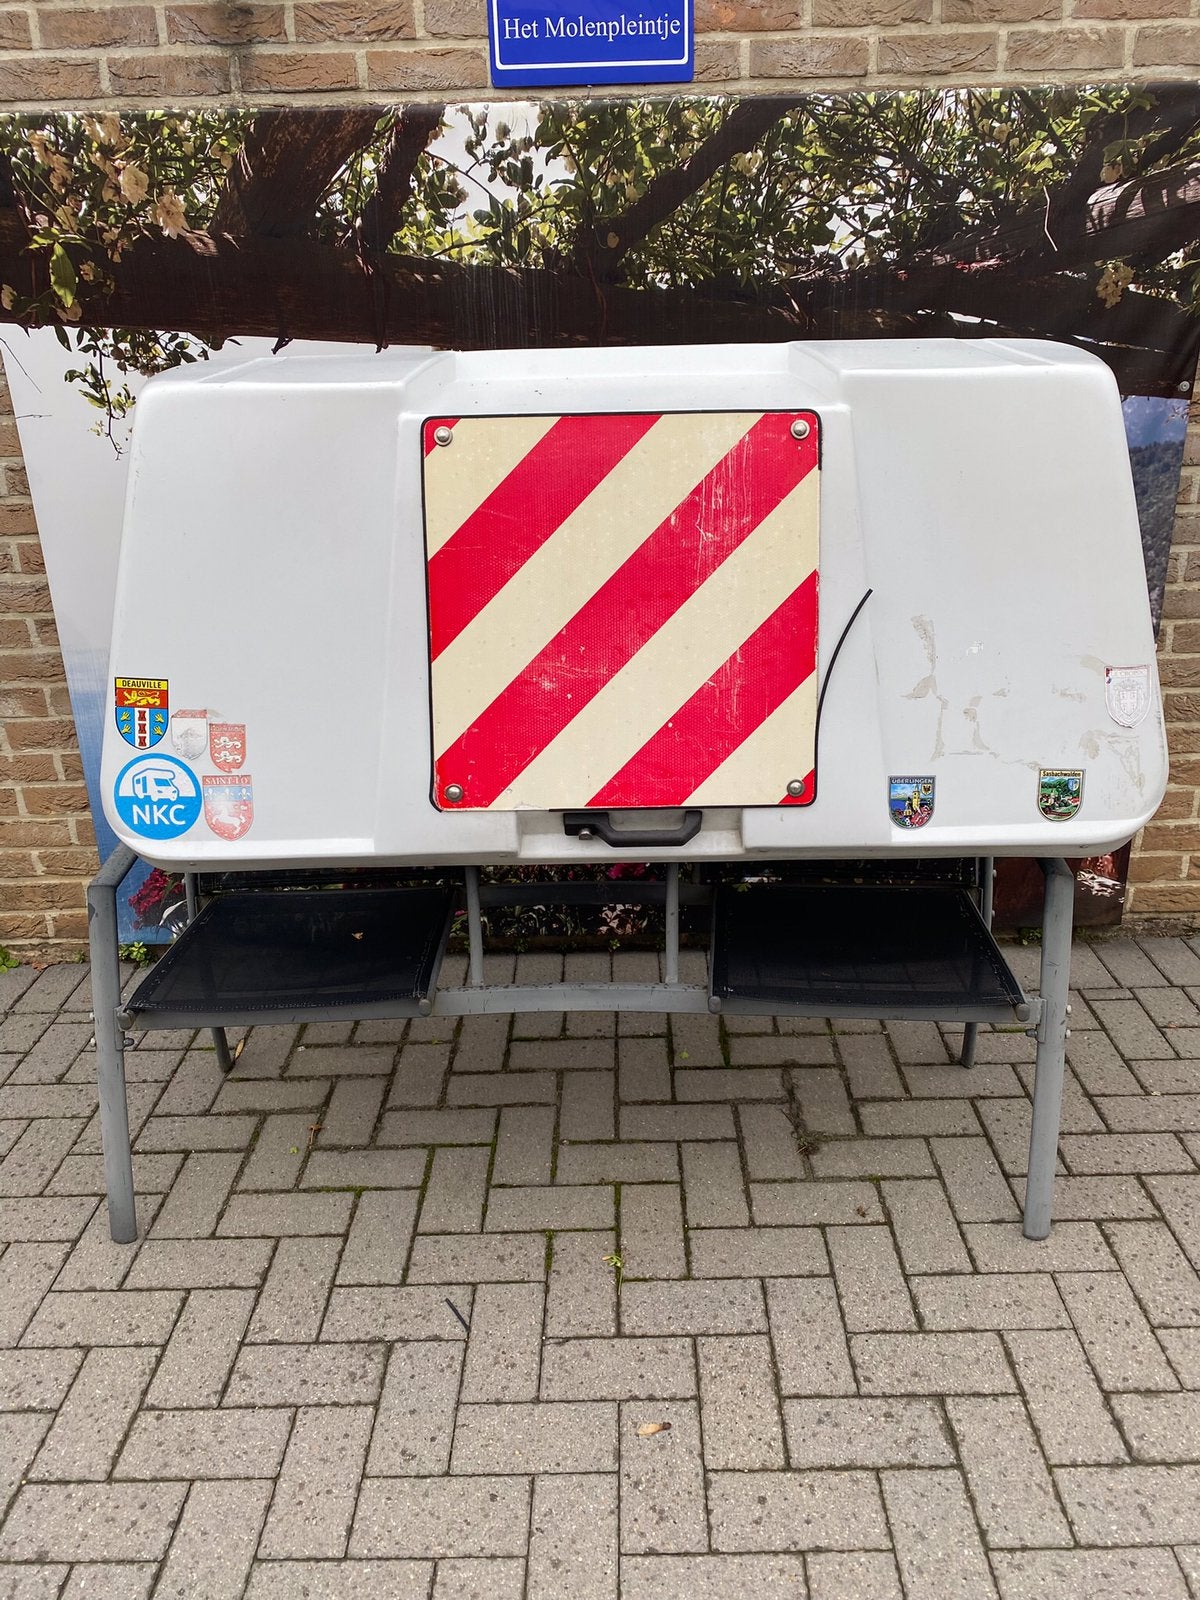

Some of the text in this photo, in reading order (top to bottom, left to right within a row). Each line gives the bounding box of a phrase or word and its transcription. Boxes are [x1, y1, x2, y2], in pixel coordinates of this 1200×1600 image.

[503, 13, 681, 42] Het Molenpleintje
[121, 679, 162, 689] DEAUVILLE
[132, 804, 186, 825] NKC
